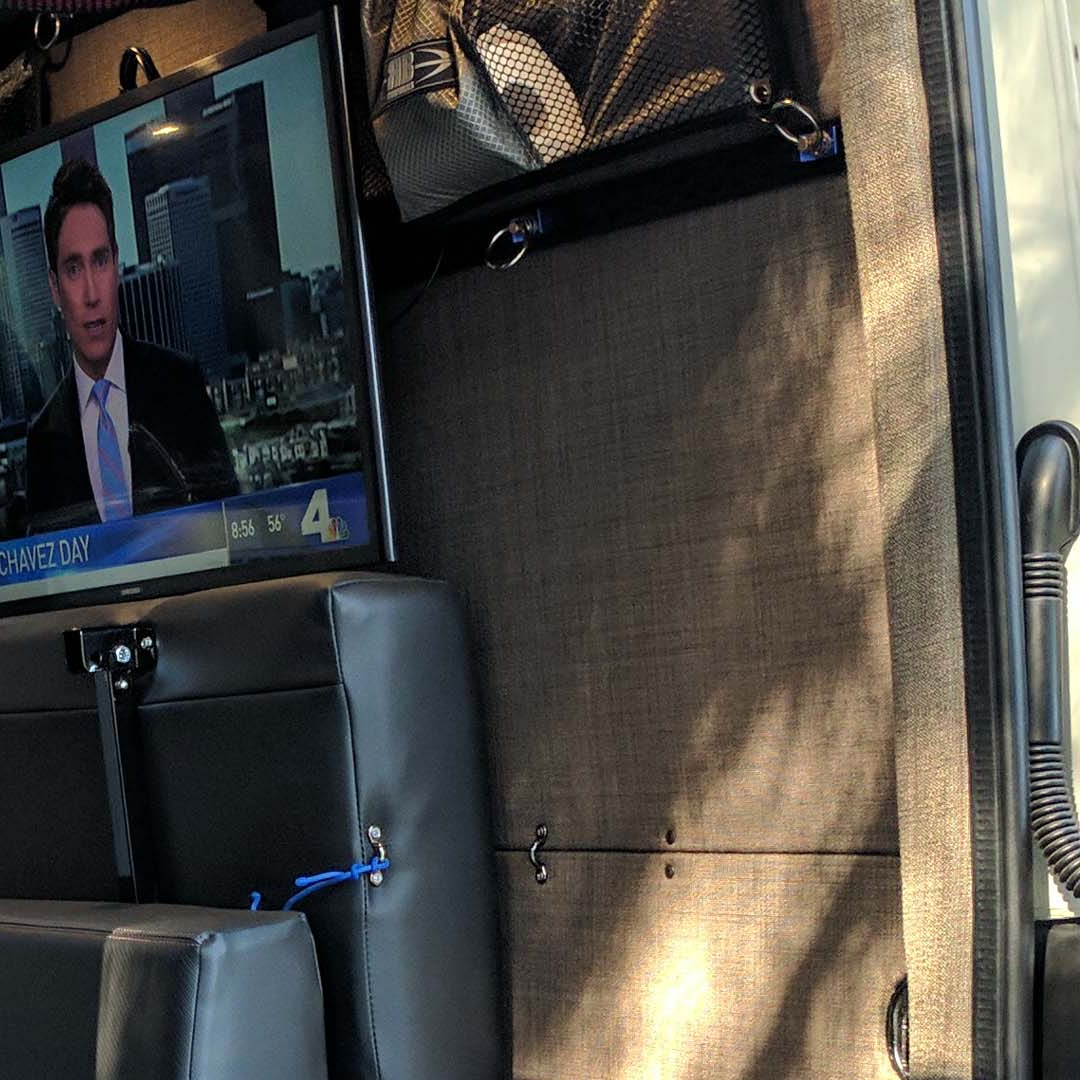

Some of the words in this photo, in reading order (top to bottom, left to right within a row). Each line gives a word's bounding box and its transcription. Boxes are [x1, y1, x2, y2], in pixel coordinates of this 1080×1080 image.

[231, 519, 255, 538] 8:56
[301, 488, 330, 544] 4
[59, 535, 90, 566] DAY
